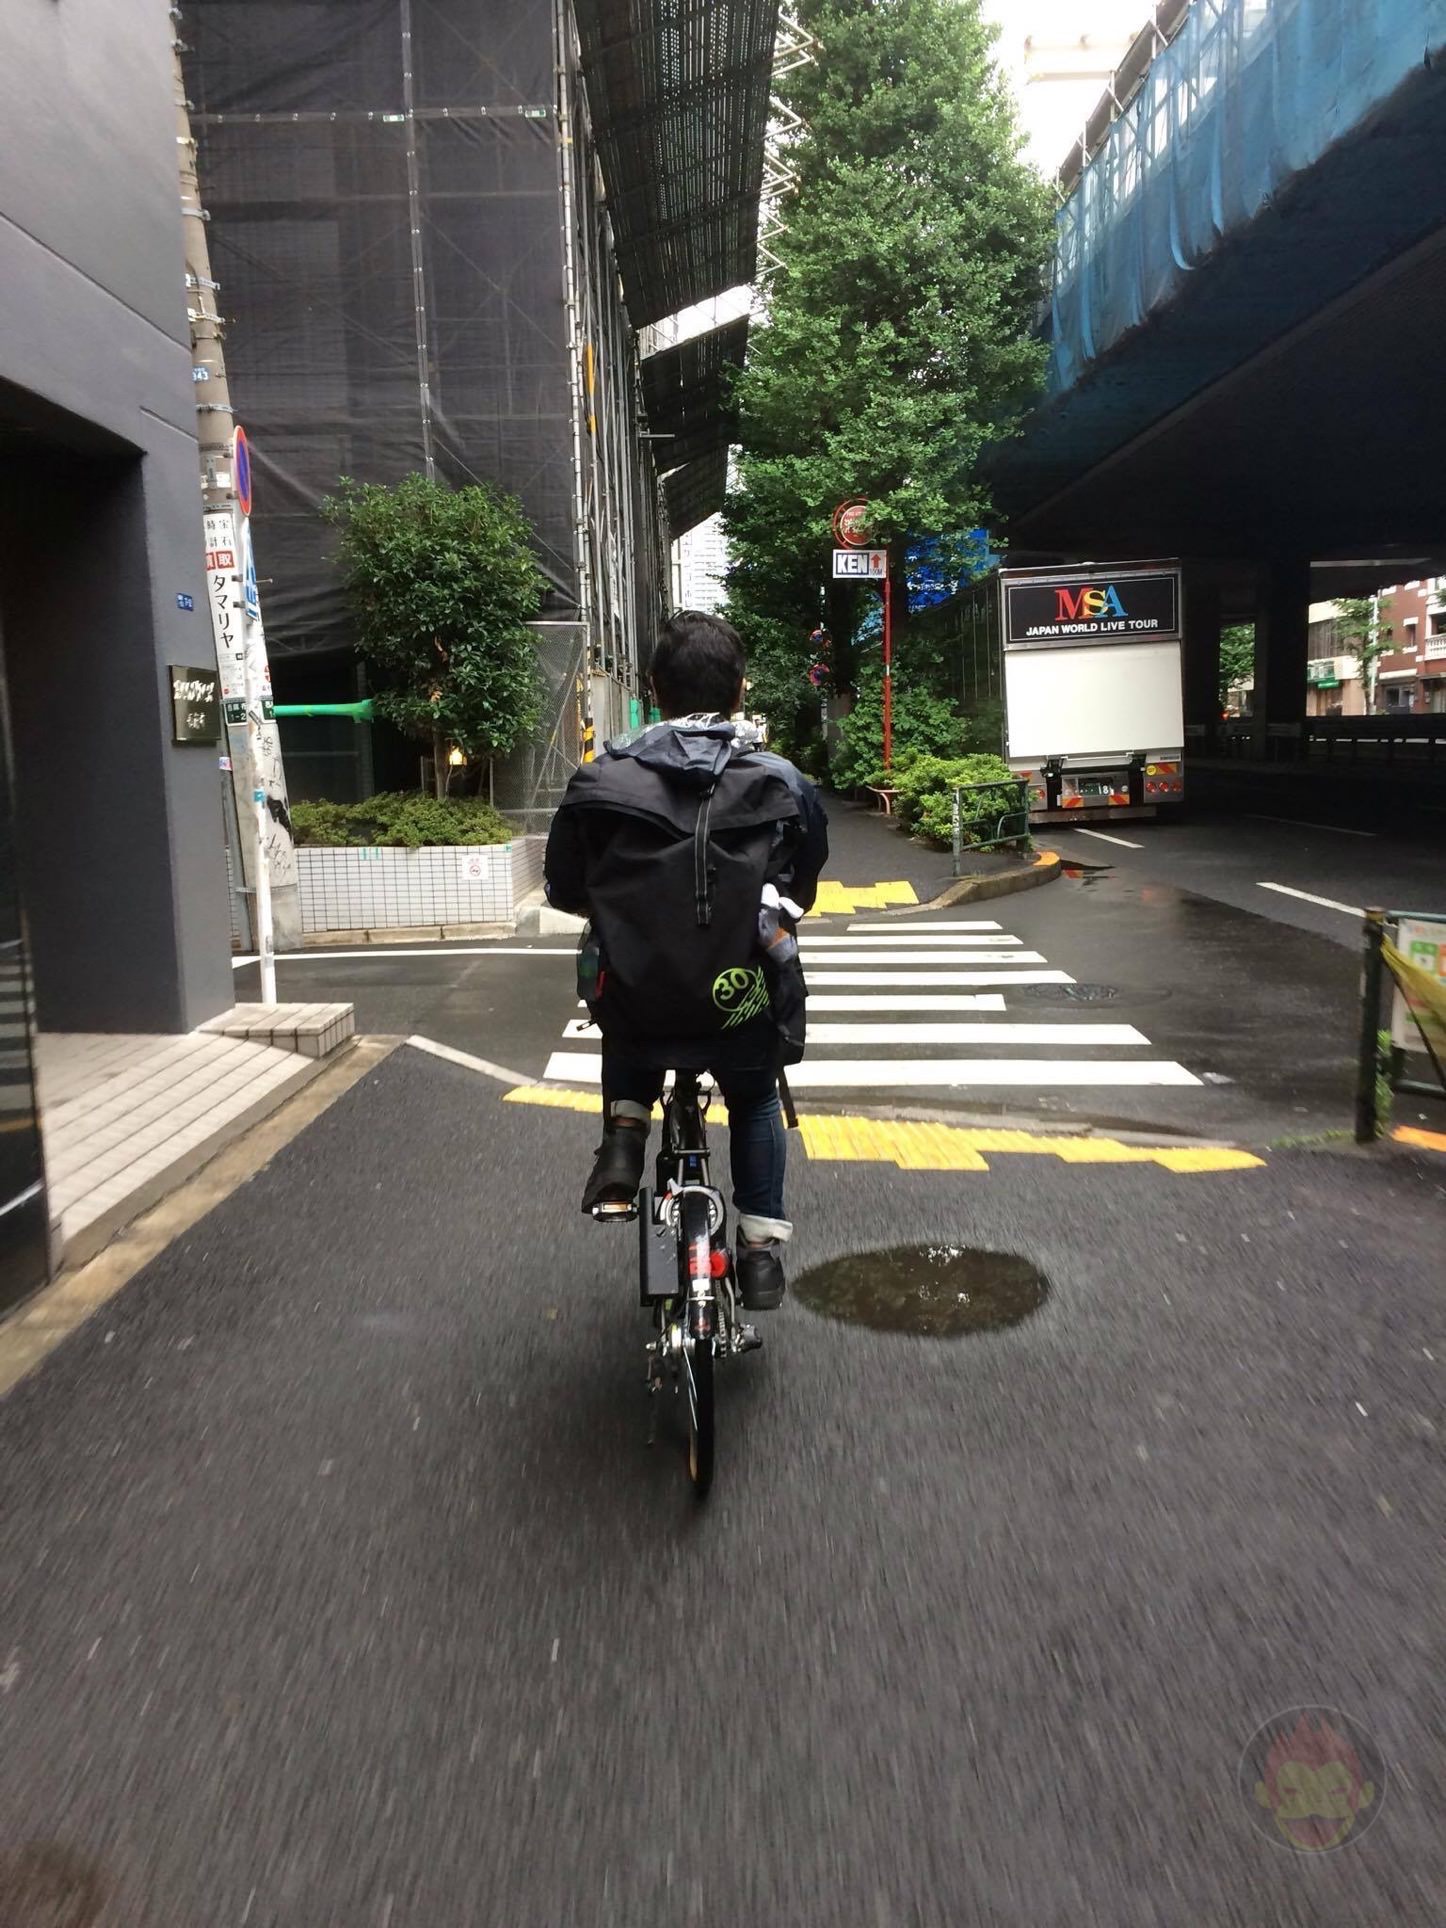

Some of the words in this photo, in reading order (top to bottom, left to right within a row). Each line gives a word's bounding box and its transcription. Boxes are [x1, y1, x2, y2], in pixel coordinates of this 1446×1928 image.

[837, 554, 868, 573] KEN
[213, 575, 234, 649] タマリヤ
[1054, 584, 1129, 620] MSA
[1026, 625, 1059, 636] JAPAN
[1061, 623, 1098, 634] WORLD
[1100, 621, 1125, 631] LIVE
[1128, 619, 1158, 630] TOUR
[715, 969, 749, 1000] 30
